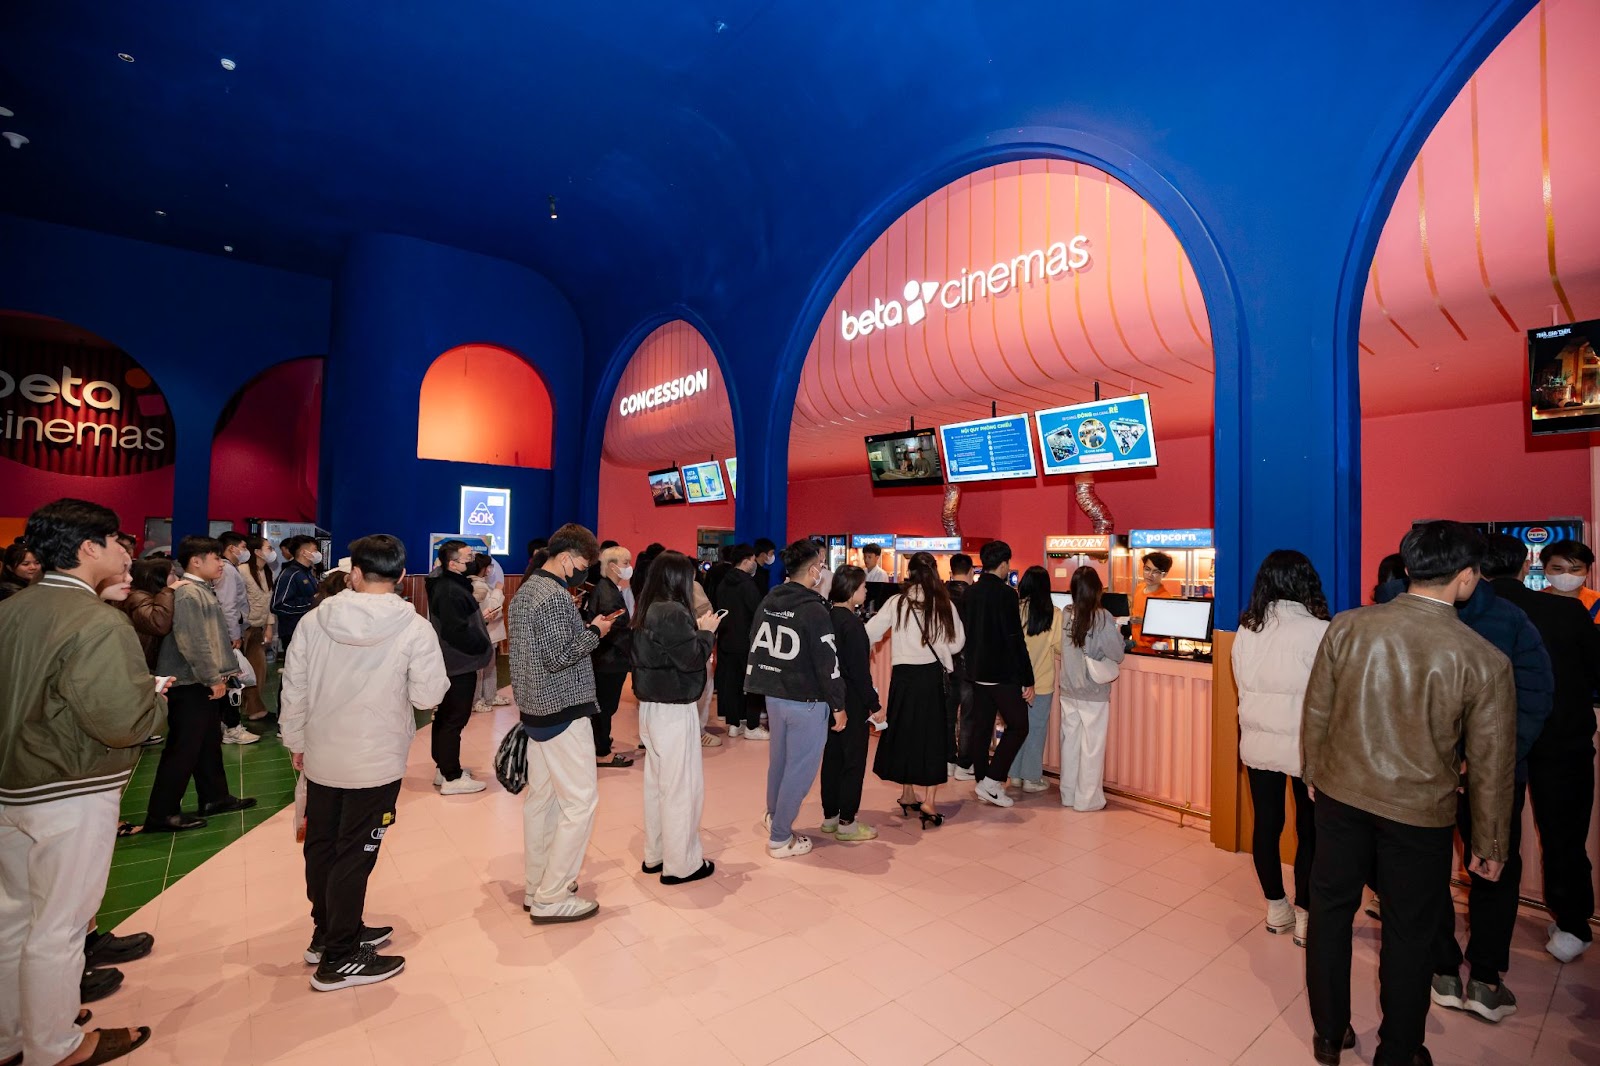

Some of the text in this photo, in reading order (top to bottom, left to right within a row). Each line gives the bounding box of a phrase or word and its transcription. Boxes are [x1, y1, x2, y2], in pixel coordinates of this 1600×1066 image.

[841, 234, 1090, 341] beta cinemas
[619, 367, 708, 417] CONCESSION
[0, 410, 165, 451] inemas
[1049, 537, 1105, 548] POPCORN
[1146, 531, 1197, 543] popcorn
